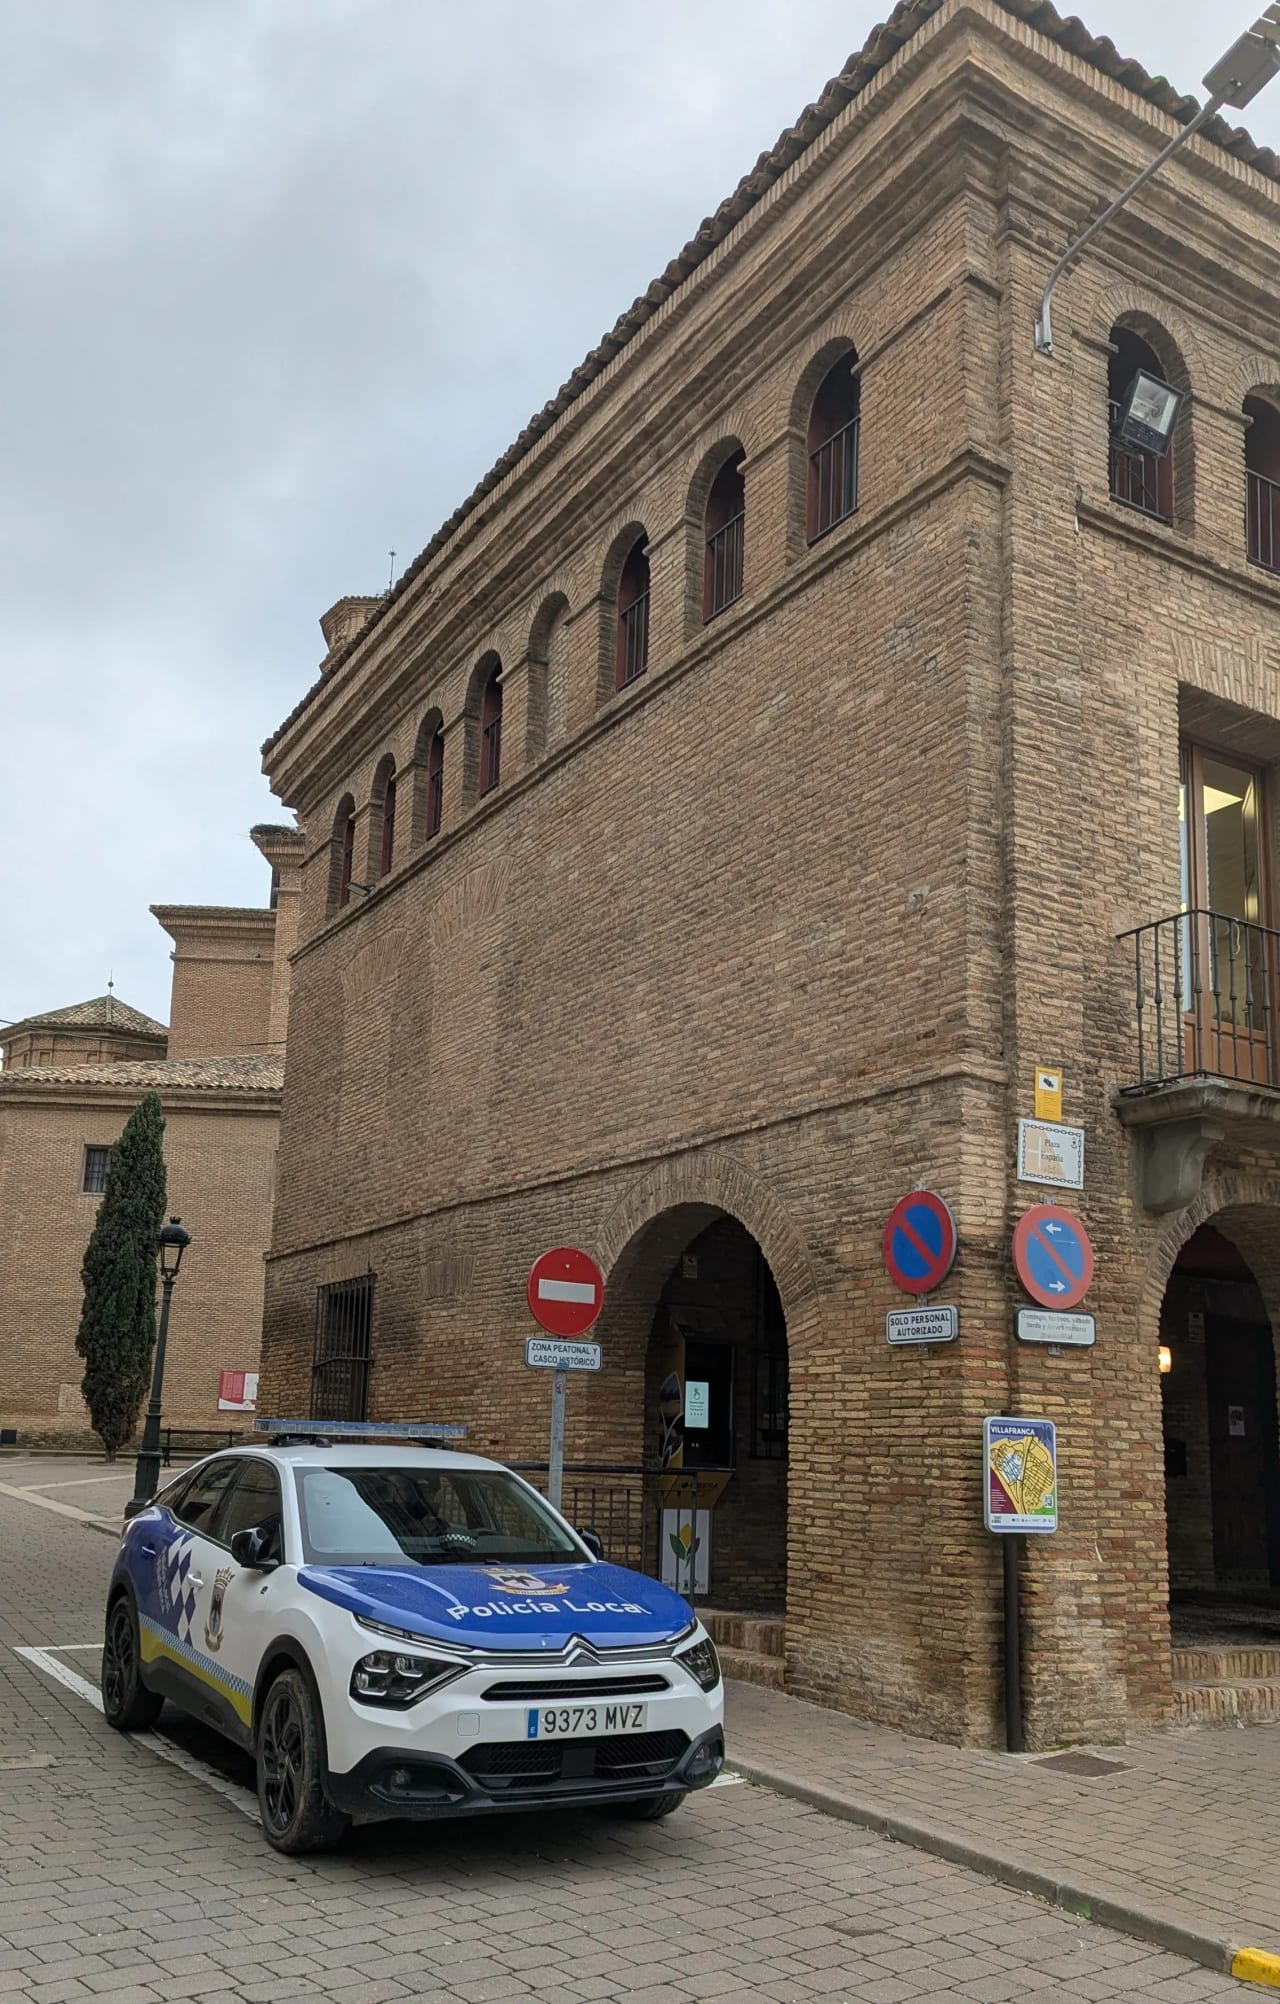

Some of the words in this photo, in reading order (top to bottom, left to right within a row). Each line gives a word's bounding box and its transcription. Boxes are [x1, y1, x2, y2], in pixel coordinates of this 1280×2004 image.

[890, 1317, 909, 1326] SOLO
[911, 1313, 950, 1324] PERSONAL
[897, 1325, 943, 1336] AUTORIZADO
[531, 1343, 552, 1352] ZONA
[553, 1345, 590, 1354] PEATONAL
[593, 1347, 598, 1355] Y
[533, 1354, 558, 1364] CASCO
[990, 1426, 1036, 1436] VILLAFRANCA
[446, 1599, 561, 1621] Policía
[562, 1599, 653, 1616] Local
[544, 1708, 597, 1733] 9373
[605, 1705, 643, 1730] MVZ
